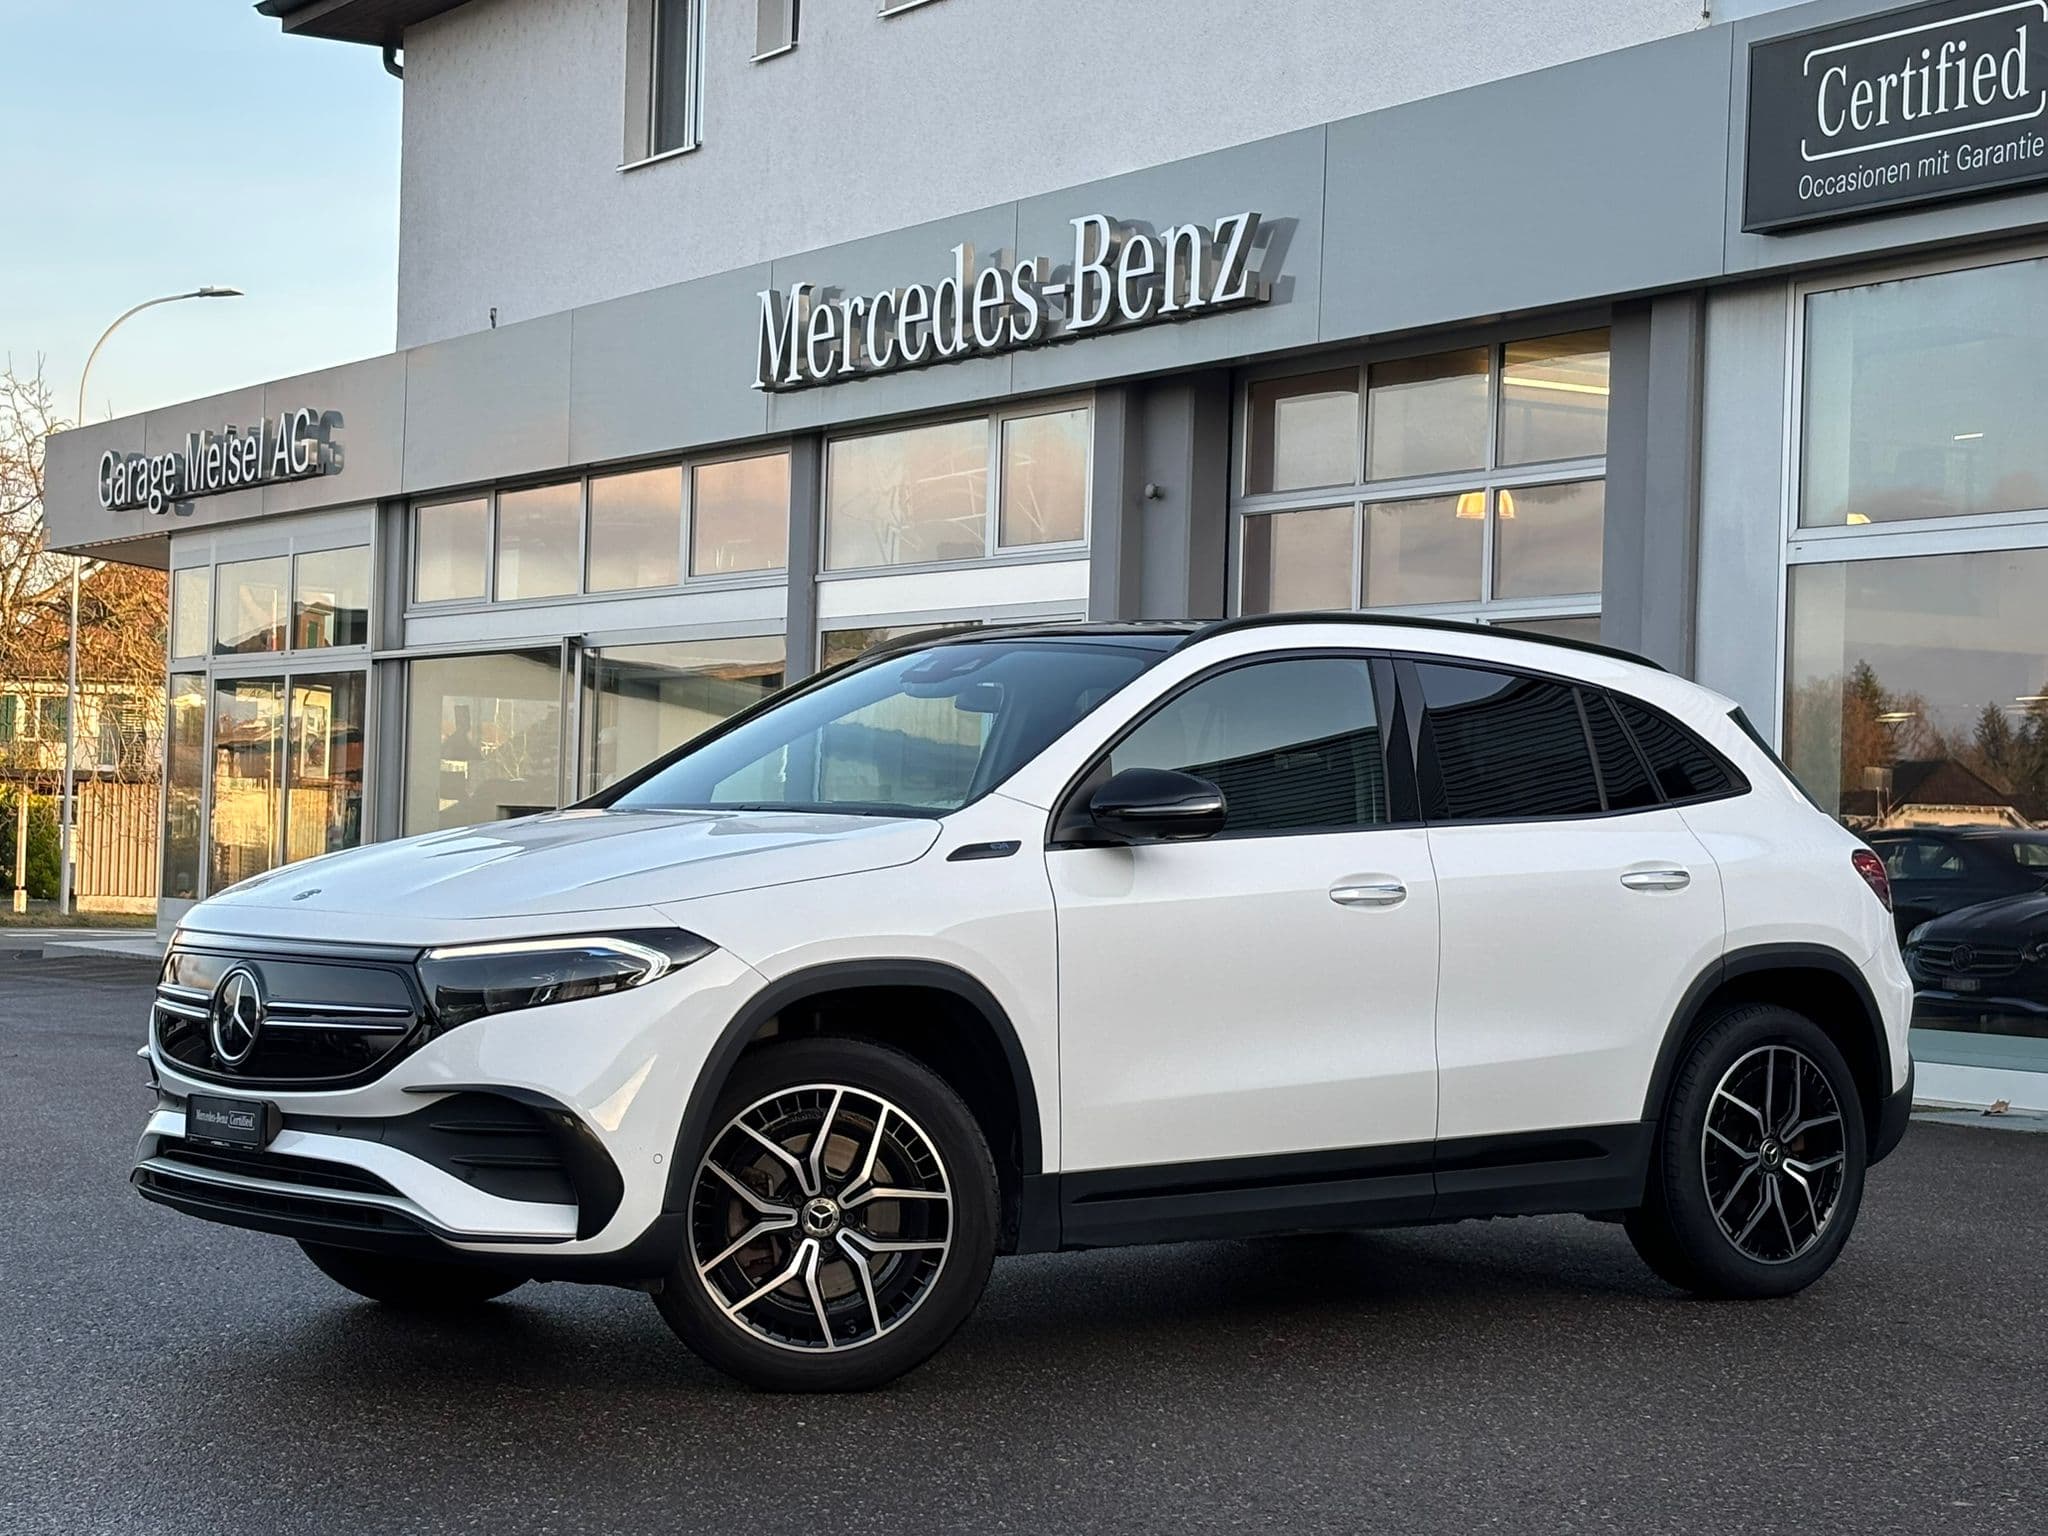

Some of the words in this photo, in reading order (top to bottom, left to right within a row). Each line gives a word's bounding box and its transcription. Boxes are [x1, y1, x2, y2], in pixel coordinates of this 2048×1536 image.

[1816, 24, 2030, 137] Certified
[1798, 161, 1911, 200] Occasionen
[1917, 149, 1950, 179] mit
[1955, 131, 2045, 171] Garantie
[750, 211, 1264, 391] Mercedes-Benz
[98, 450, 177, 515] Garage
[183, 416, 266, 493] Meisel
[271, 407, 312, 477] AG
